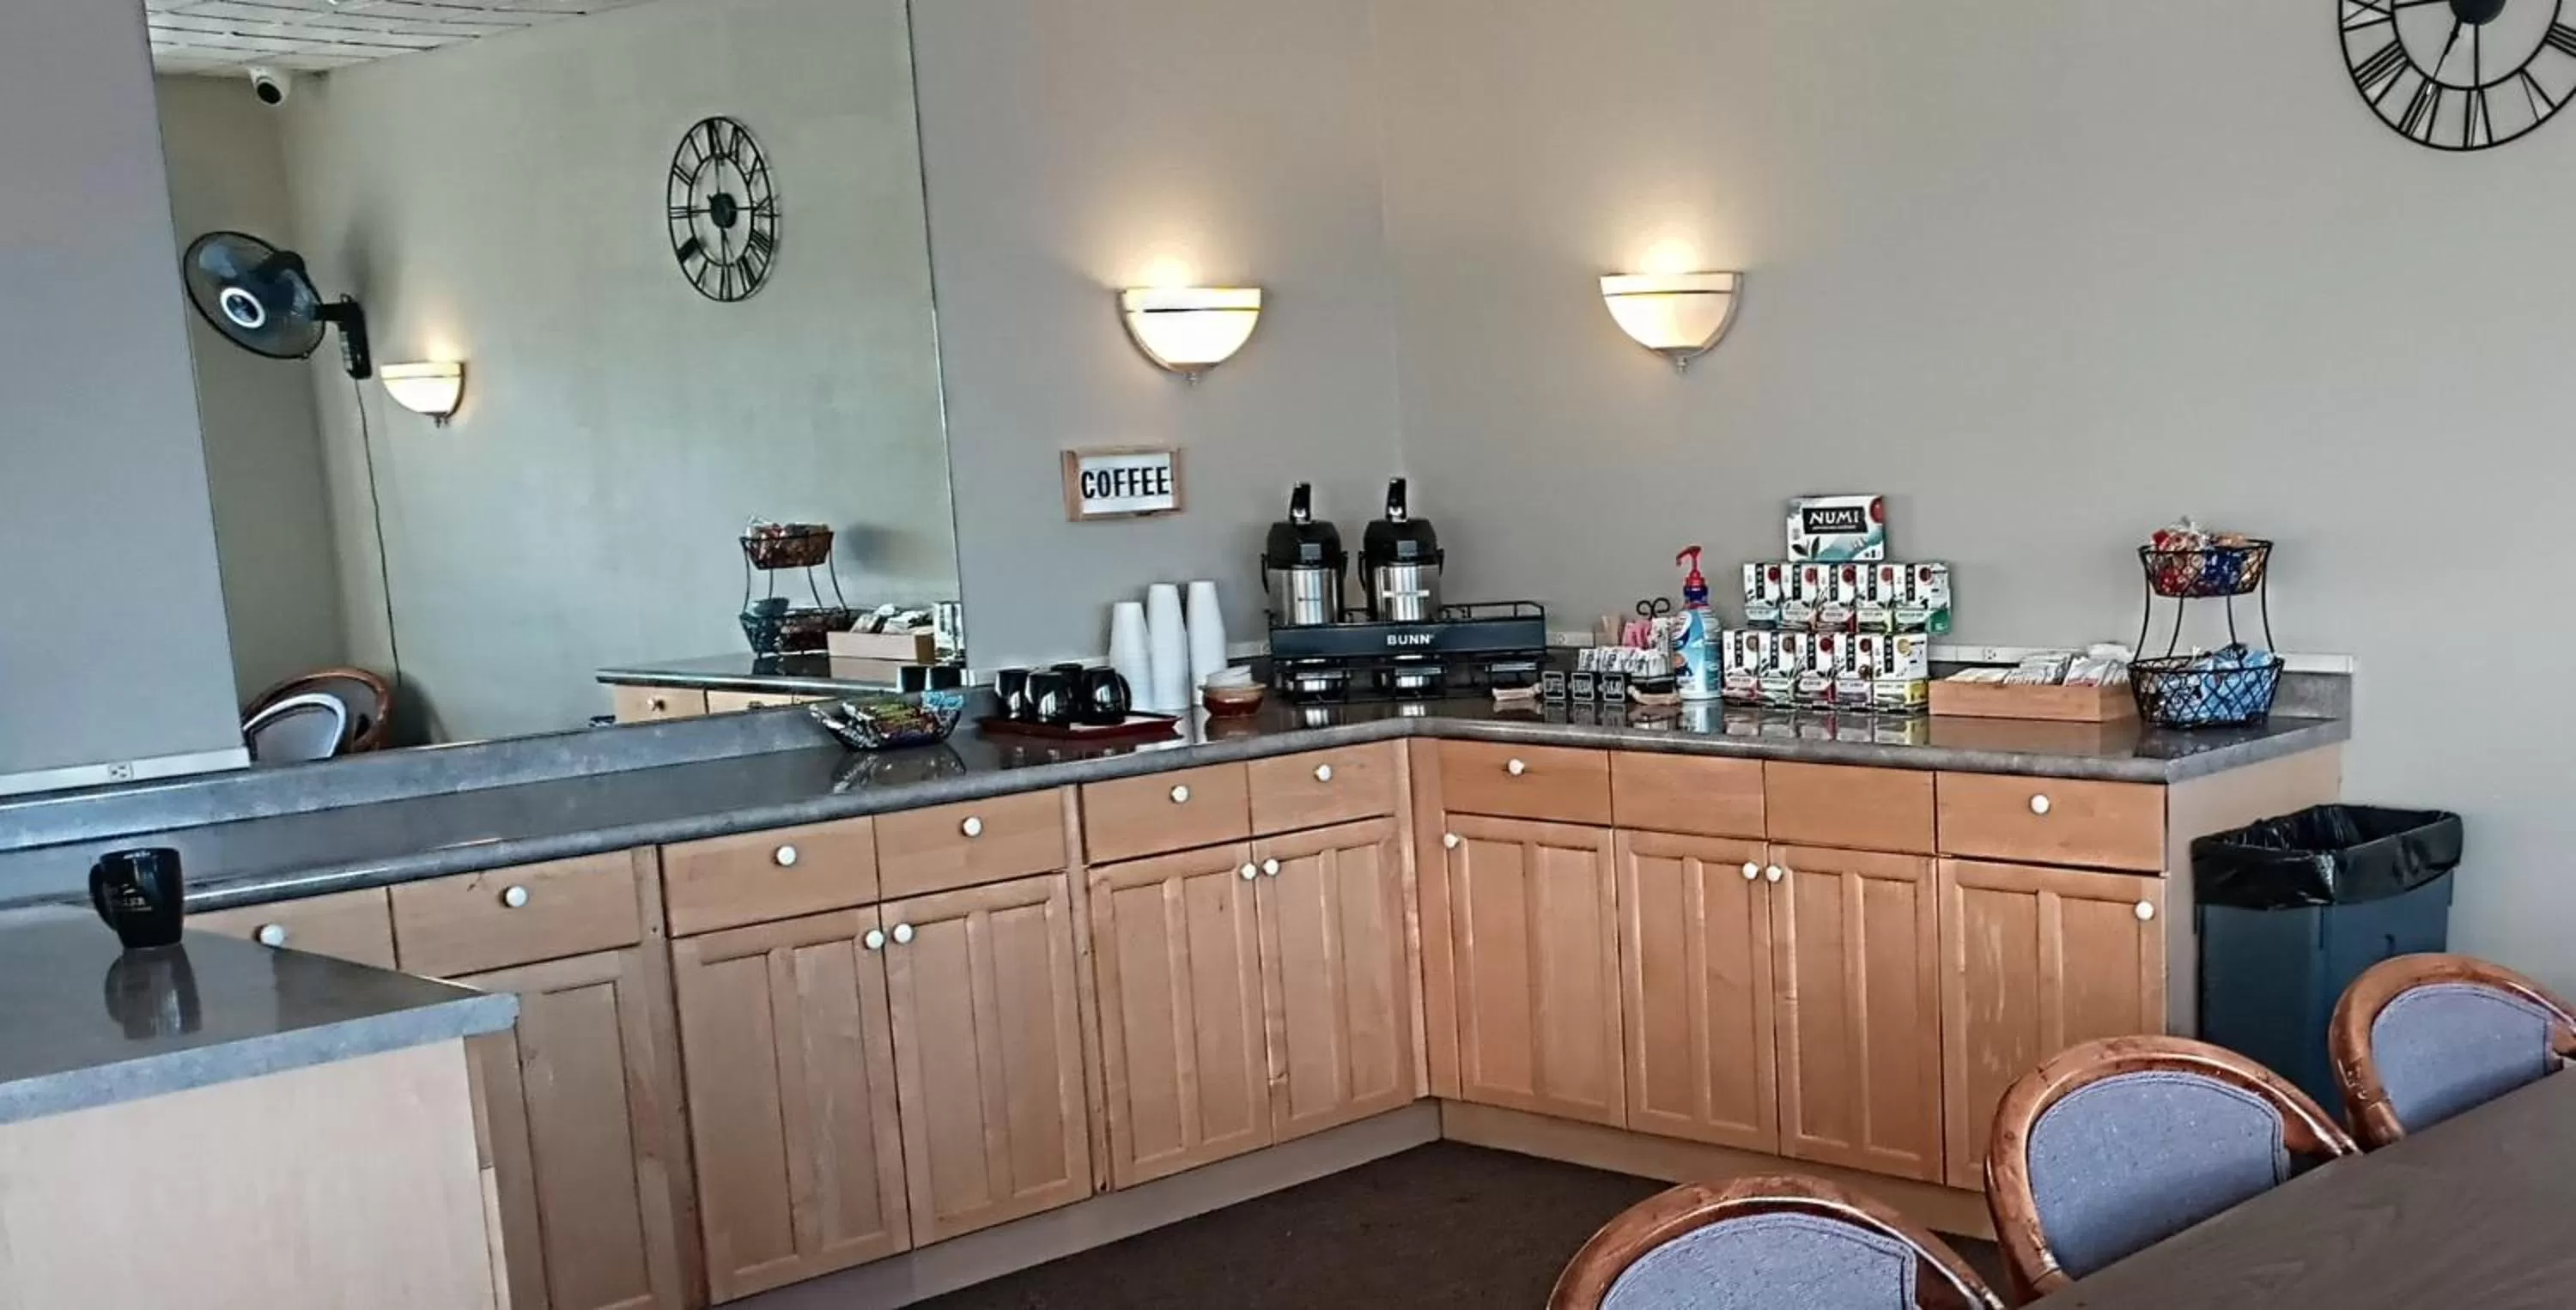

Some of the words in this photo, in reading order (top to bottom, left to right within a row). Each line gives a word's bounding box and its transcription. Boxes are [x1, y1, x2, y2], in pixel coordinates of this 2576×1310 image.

[1081, 466, 1170, 499] COFFEE
[1809, 511, 1859, 525] NUMI
[1387, 634, 1430, 646] BUNN
